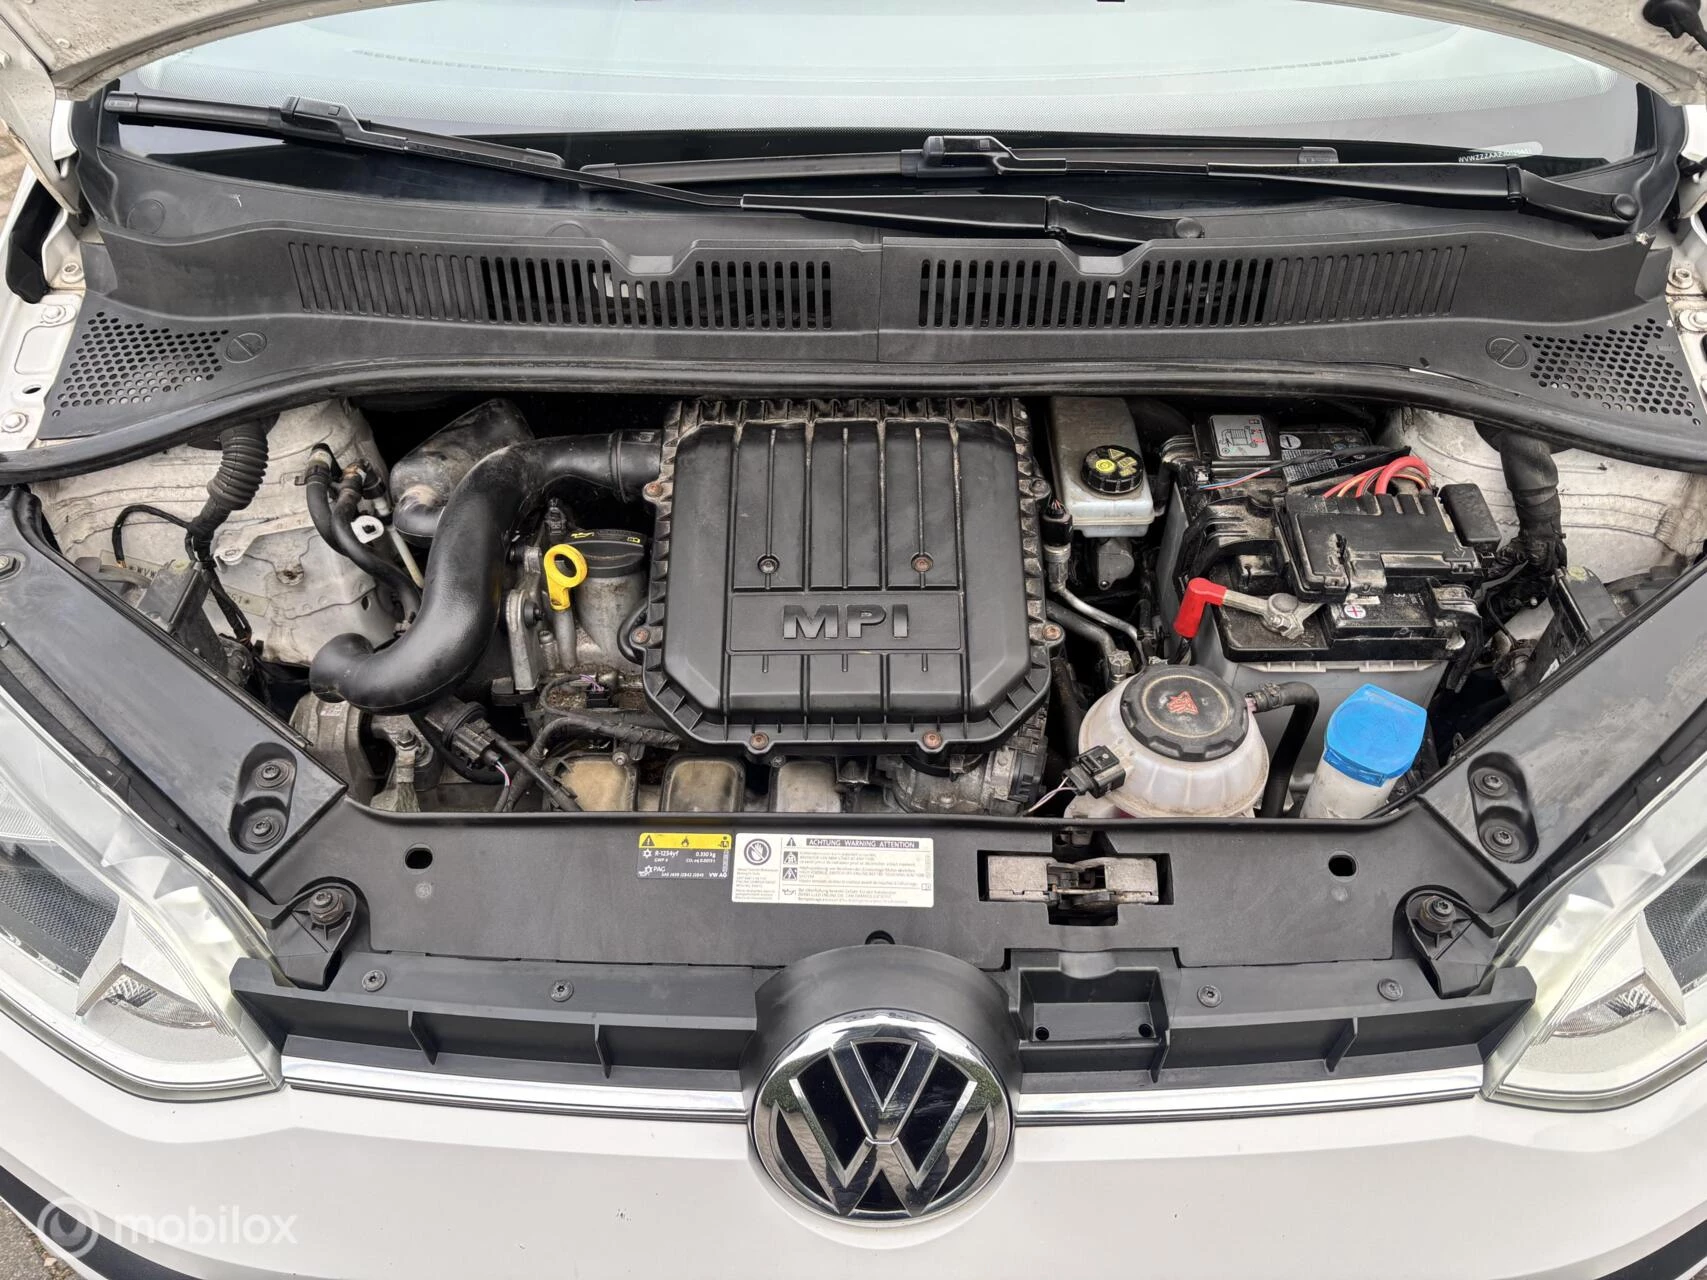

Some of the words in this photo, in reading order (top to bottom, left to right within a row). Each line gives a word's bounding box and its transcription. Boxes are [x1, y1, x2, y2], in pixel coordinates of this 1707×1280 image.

[783, 603, 909, 640] MPI
[808, 838, 841, 847] ACHTUNG
[844, 839, 876, 848] WARNING
[879, 840, 915, 849] ATTENTION
[773, 1034, 994, 1219] VW
